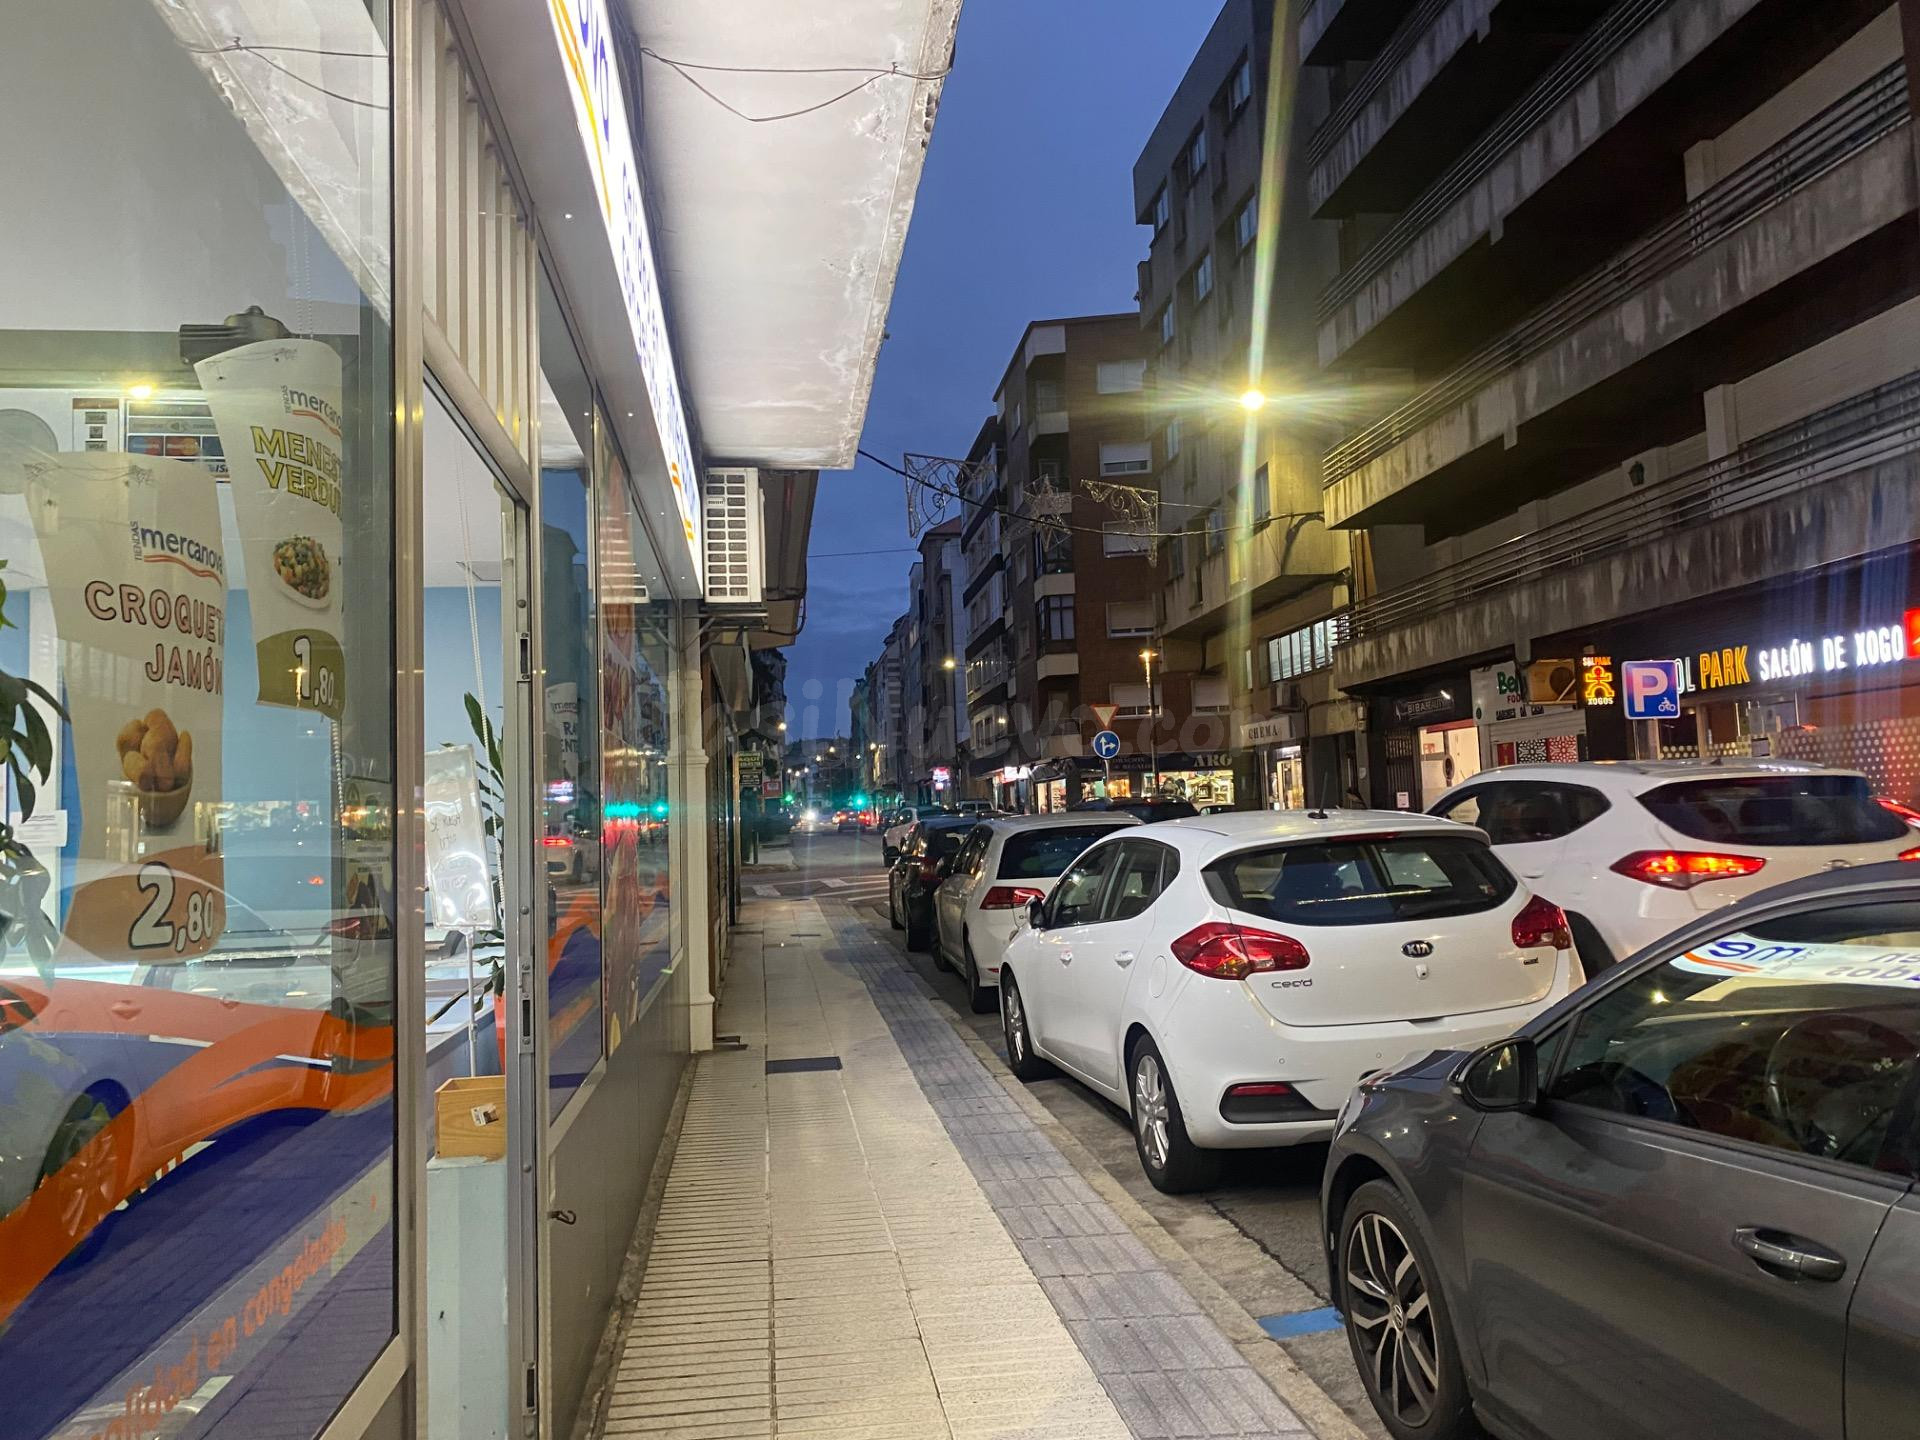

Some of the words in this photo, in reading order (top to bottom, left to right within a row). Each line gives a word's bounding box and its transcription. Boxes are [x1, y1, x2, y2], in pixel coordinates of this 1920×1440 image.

[130, 520, 143, 561] TIENDAS
[294, 635, 335, 707] 1,80
[1699, 645, 1750, 690] PARK
[1758, 638, 1813, 681] SALÓN
[1823, 635, 1846, 672] DE
[1854, 624, 1904, 667] XOGO
[1587, 697, 1614, 706] XOGOS
[1631, 667, 1669, 713] P
[128, 861, 214, 953] 2,80
[1407, 942, 1431, 955] KIA
